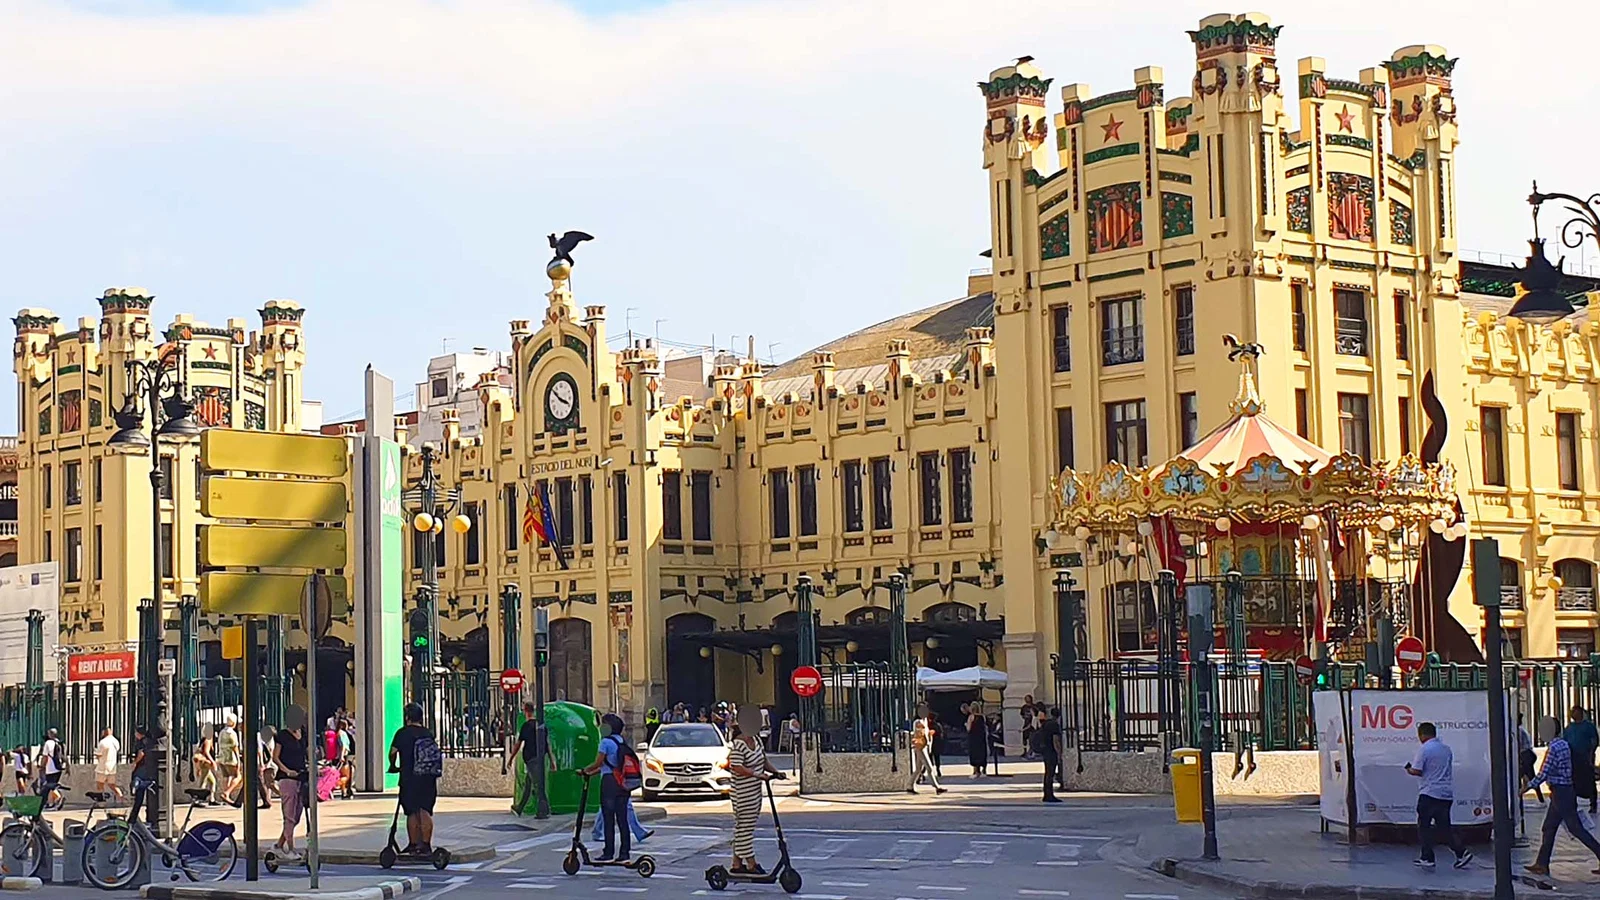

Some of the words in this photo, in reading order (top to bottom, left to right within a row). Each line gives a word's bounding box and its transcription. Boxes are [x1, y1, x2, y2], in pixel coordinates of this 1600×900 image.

[560, 459, 574, 471] DEL
[78, 660, 97, 674] RENT
[97, 660, 104, 672] A
[104, 658, 122, 672] BIKE
[1361, 704, 1413, 729] MG
